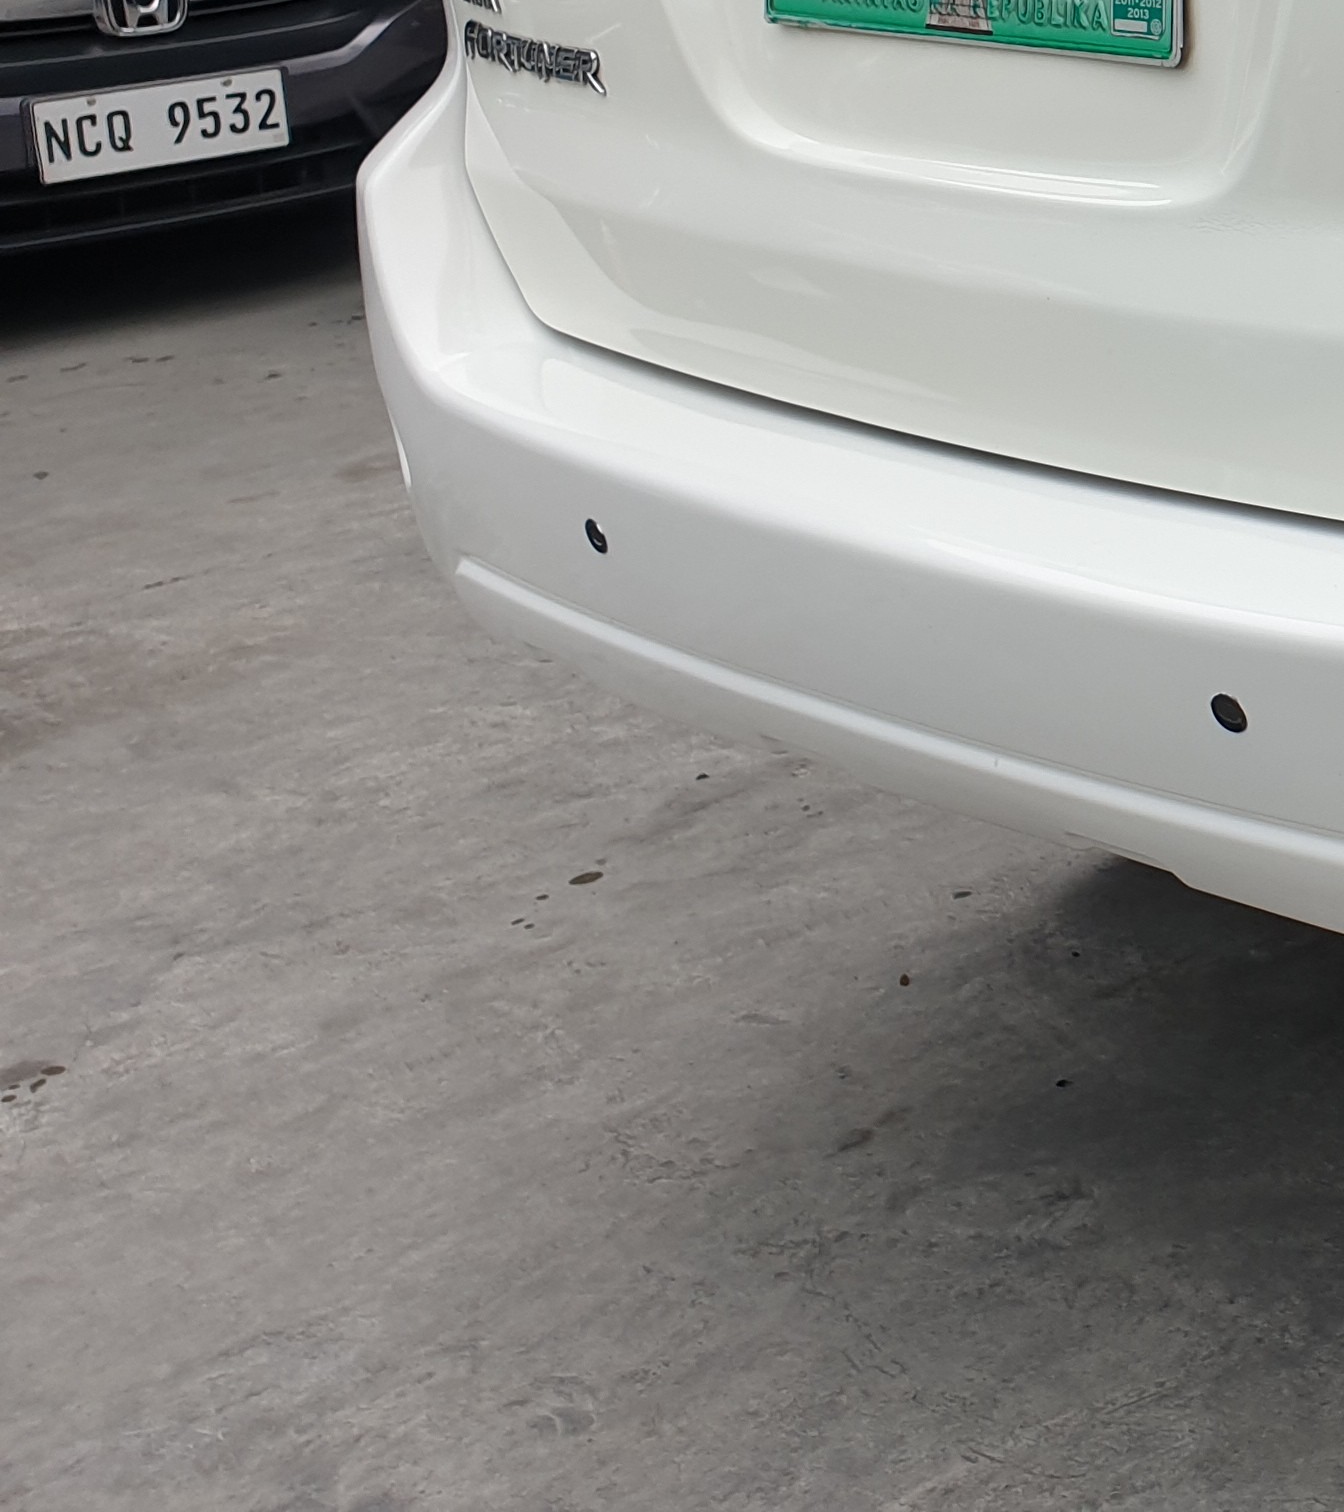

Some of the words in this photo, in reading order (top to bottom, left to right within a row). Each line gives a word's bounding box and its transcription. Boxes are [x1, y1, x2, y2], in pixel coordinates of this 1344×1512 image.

[1127, 7, 1149, 19] 2013
[464, 19, 607, 96] FORTUNER
[44, 110, 134, 164] NCQ
[168, 89, 280, 145] 9532
